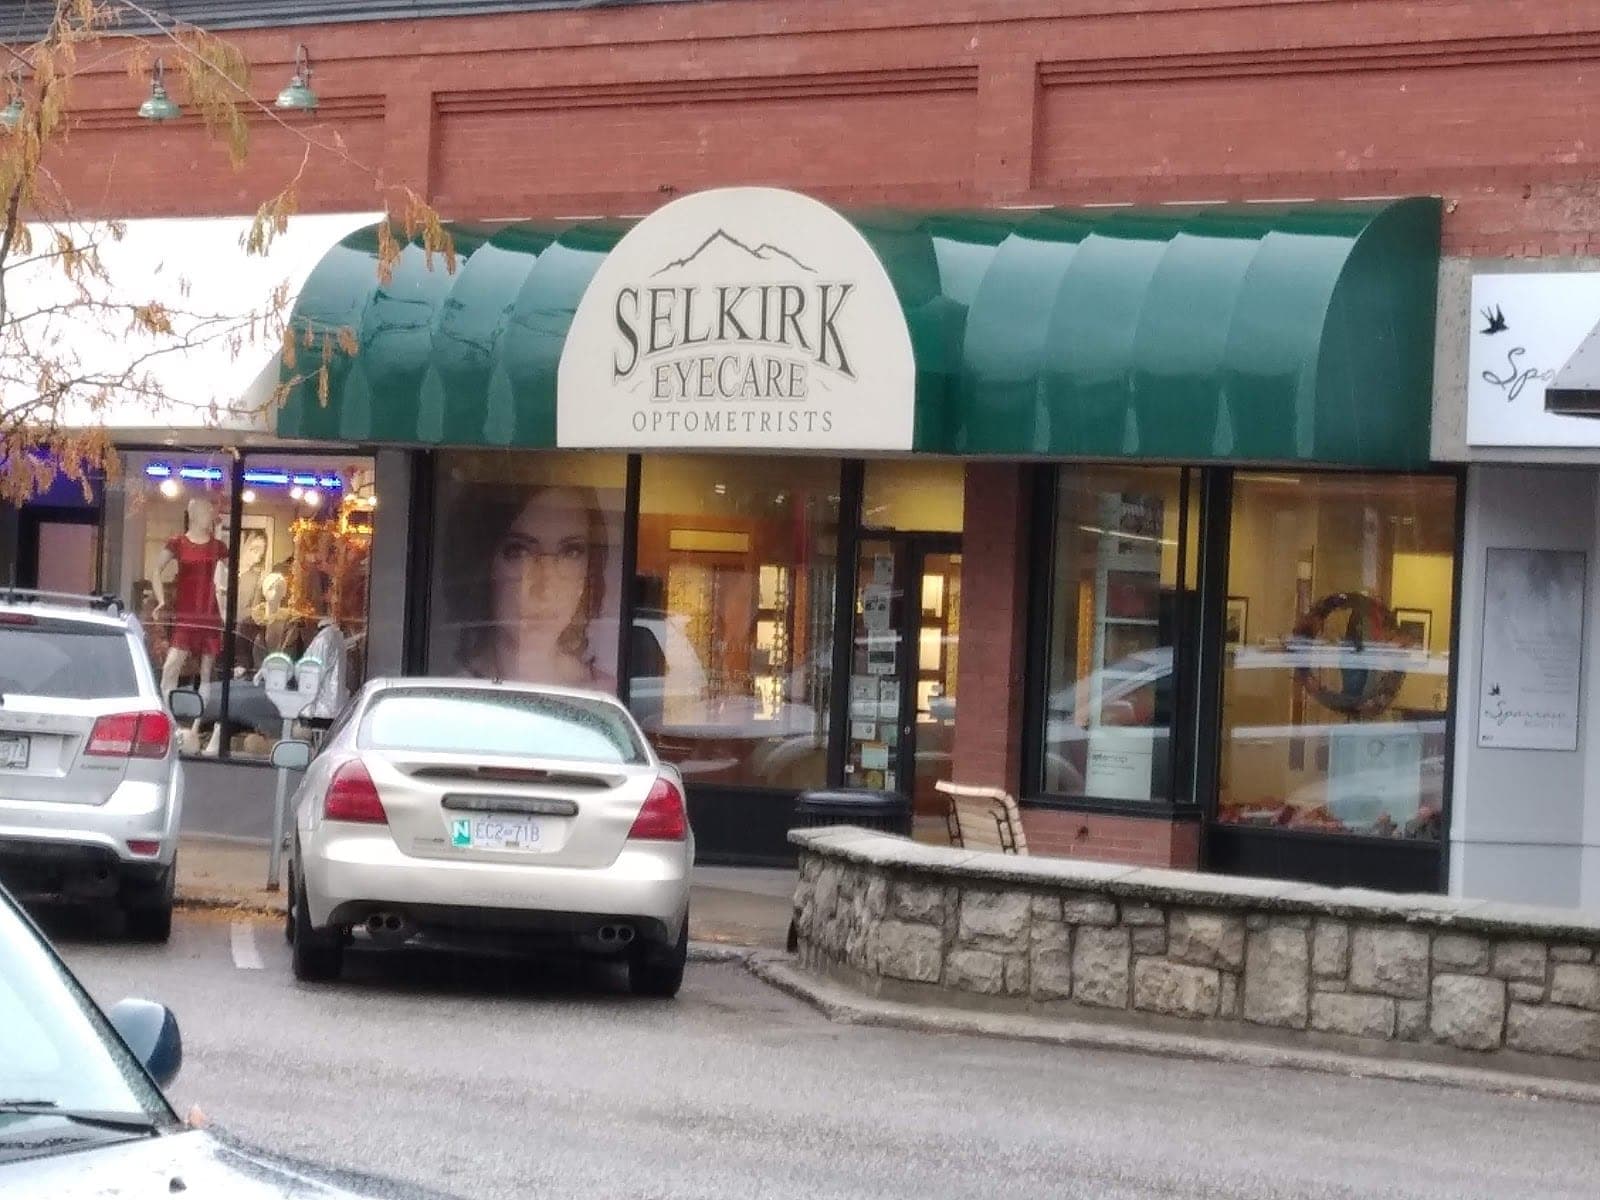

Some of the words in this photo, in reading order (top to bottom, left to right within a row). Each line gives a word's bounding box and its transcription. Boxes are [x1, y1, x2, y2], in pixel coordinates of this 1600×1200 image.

[613, 282, 856, 378] SELKIRK
[654, 354, 806, 399] EYECARE
[632, 410, 833, 432] OPTOMETRISTS
